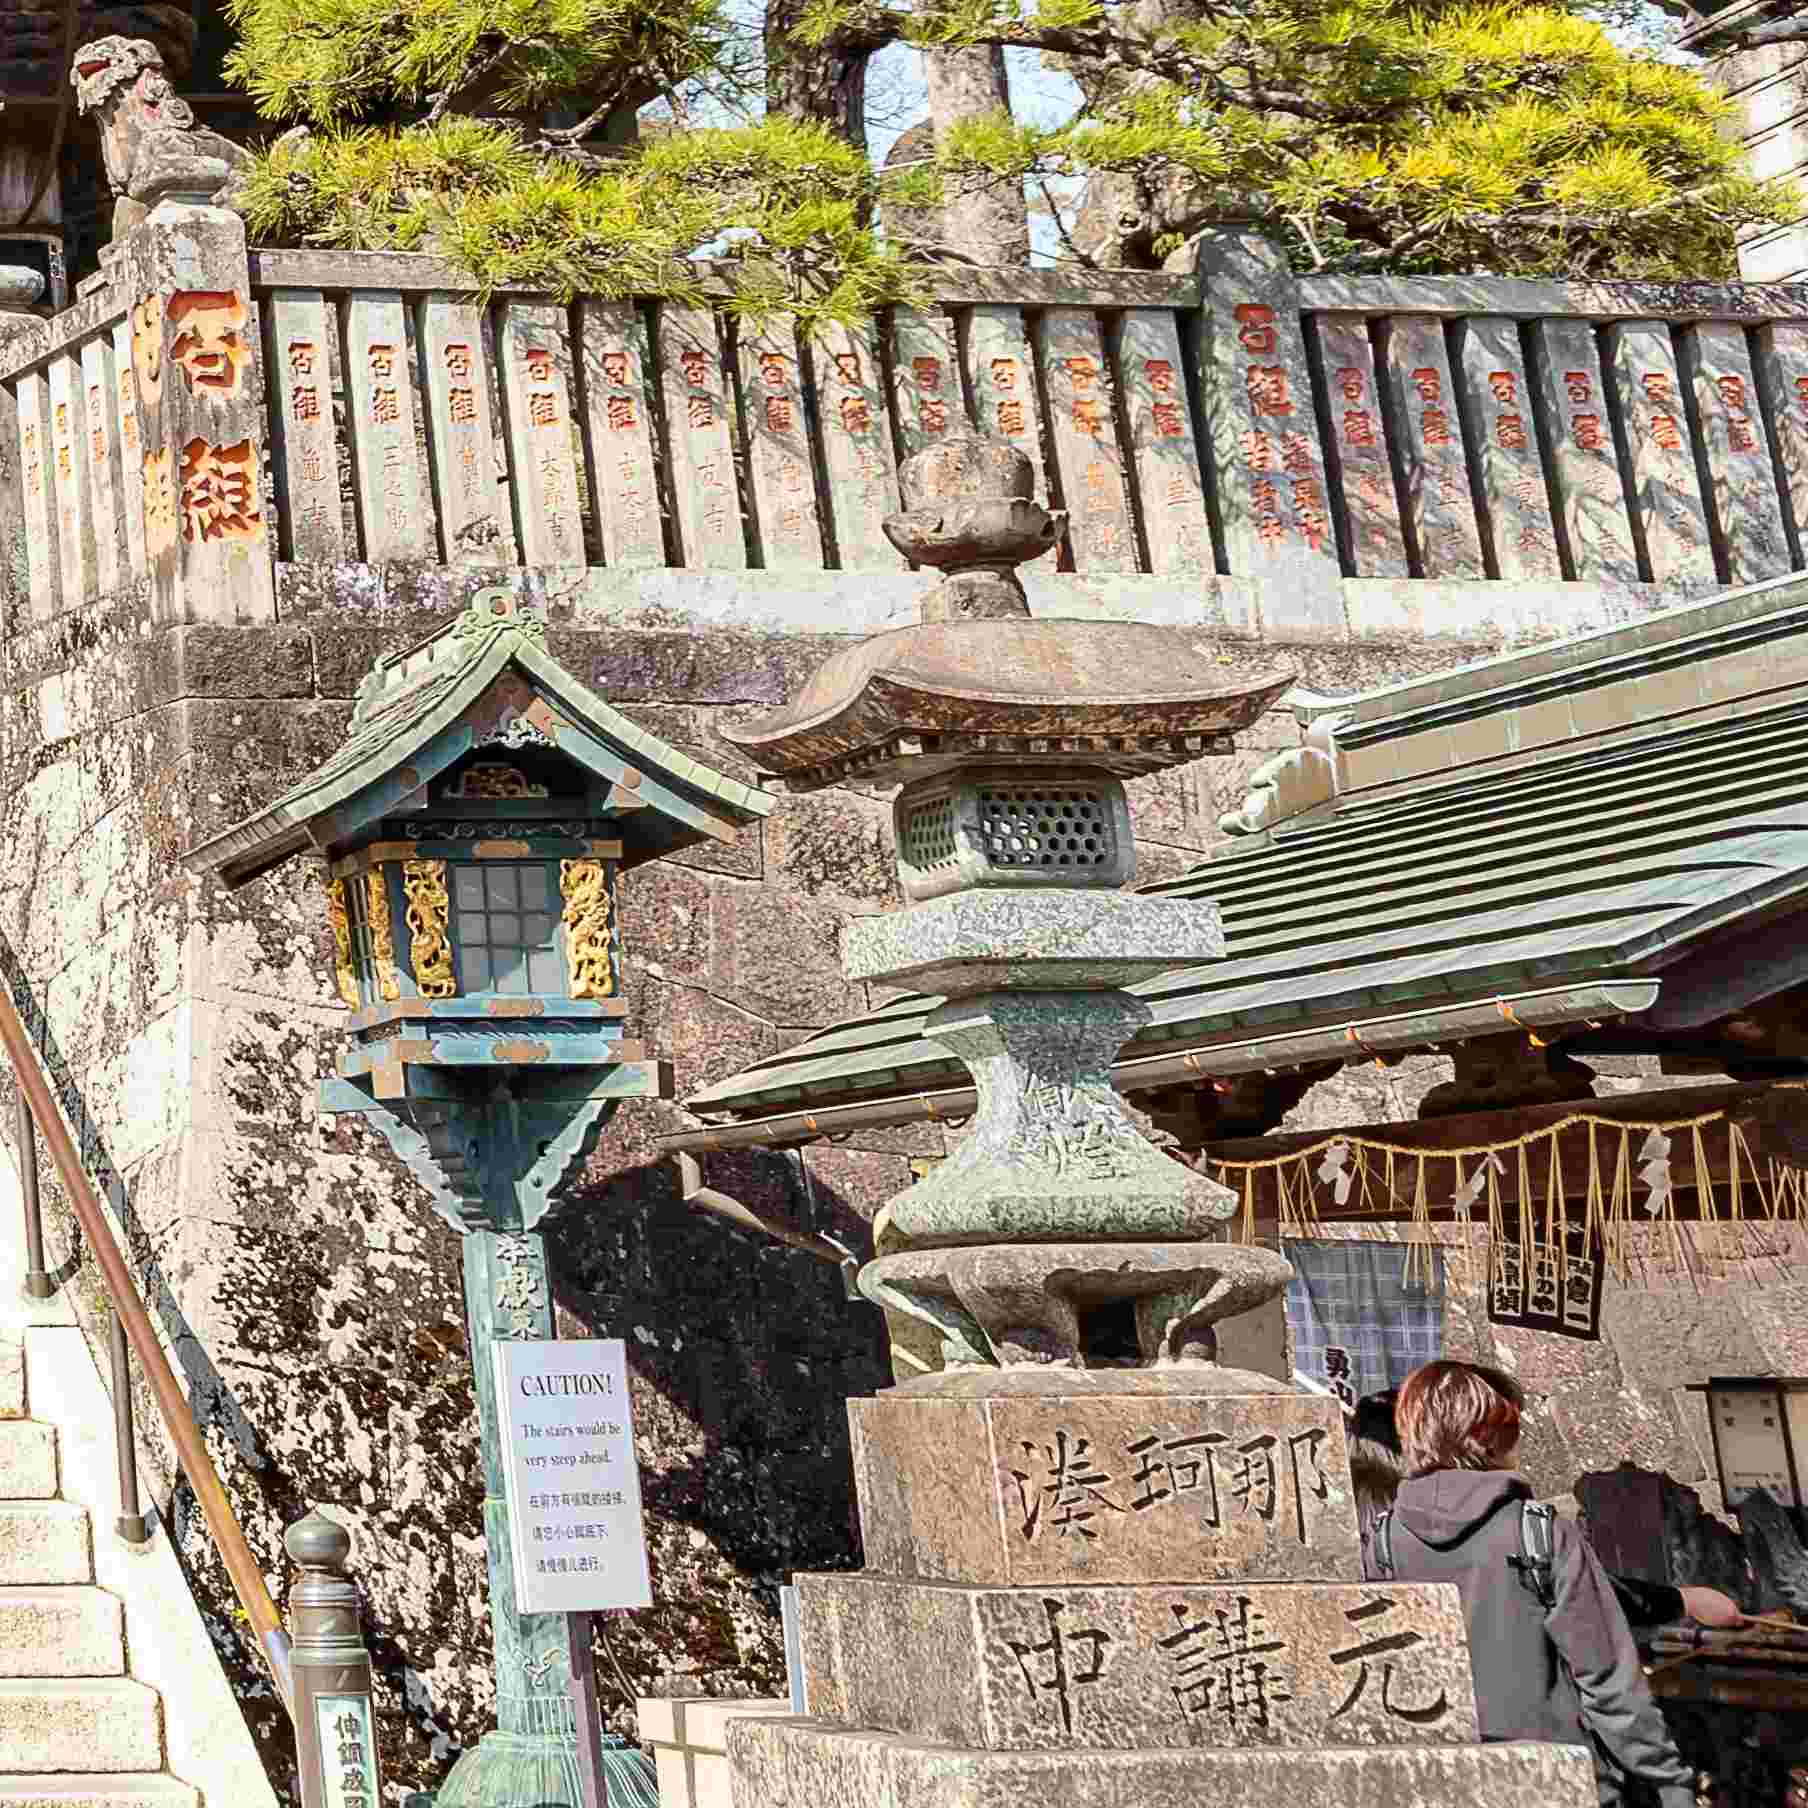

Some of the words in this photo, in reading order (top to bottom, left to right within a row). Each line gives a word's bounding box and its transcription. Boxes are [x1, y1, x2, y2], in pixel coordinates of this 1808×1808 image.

[519, 1373, 614, 1397] CAUTION!
[522, 1423, 543, 1438] The
[545, 1424, 574, 1437] stairs
[576, 1422, 607, 1436] would
[608, 1422, 622, 1435] be
[524, 1454, 549, 1468] very
[551, 1452, 577, 1467] steep
[578, 1449, 613, 1465] ahead.
